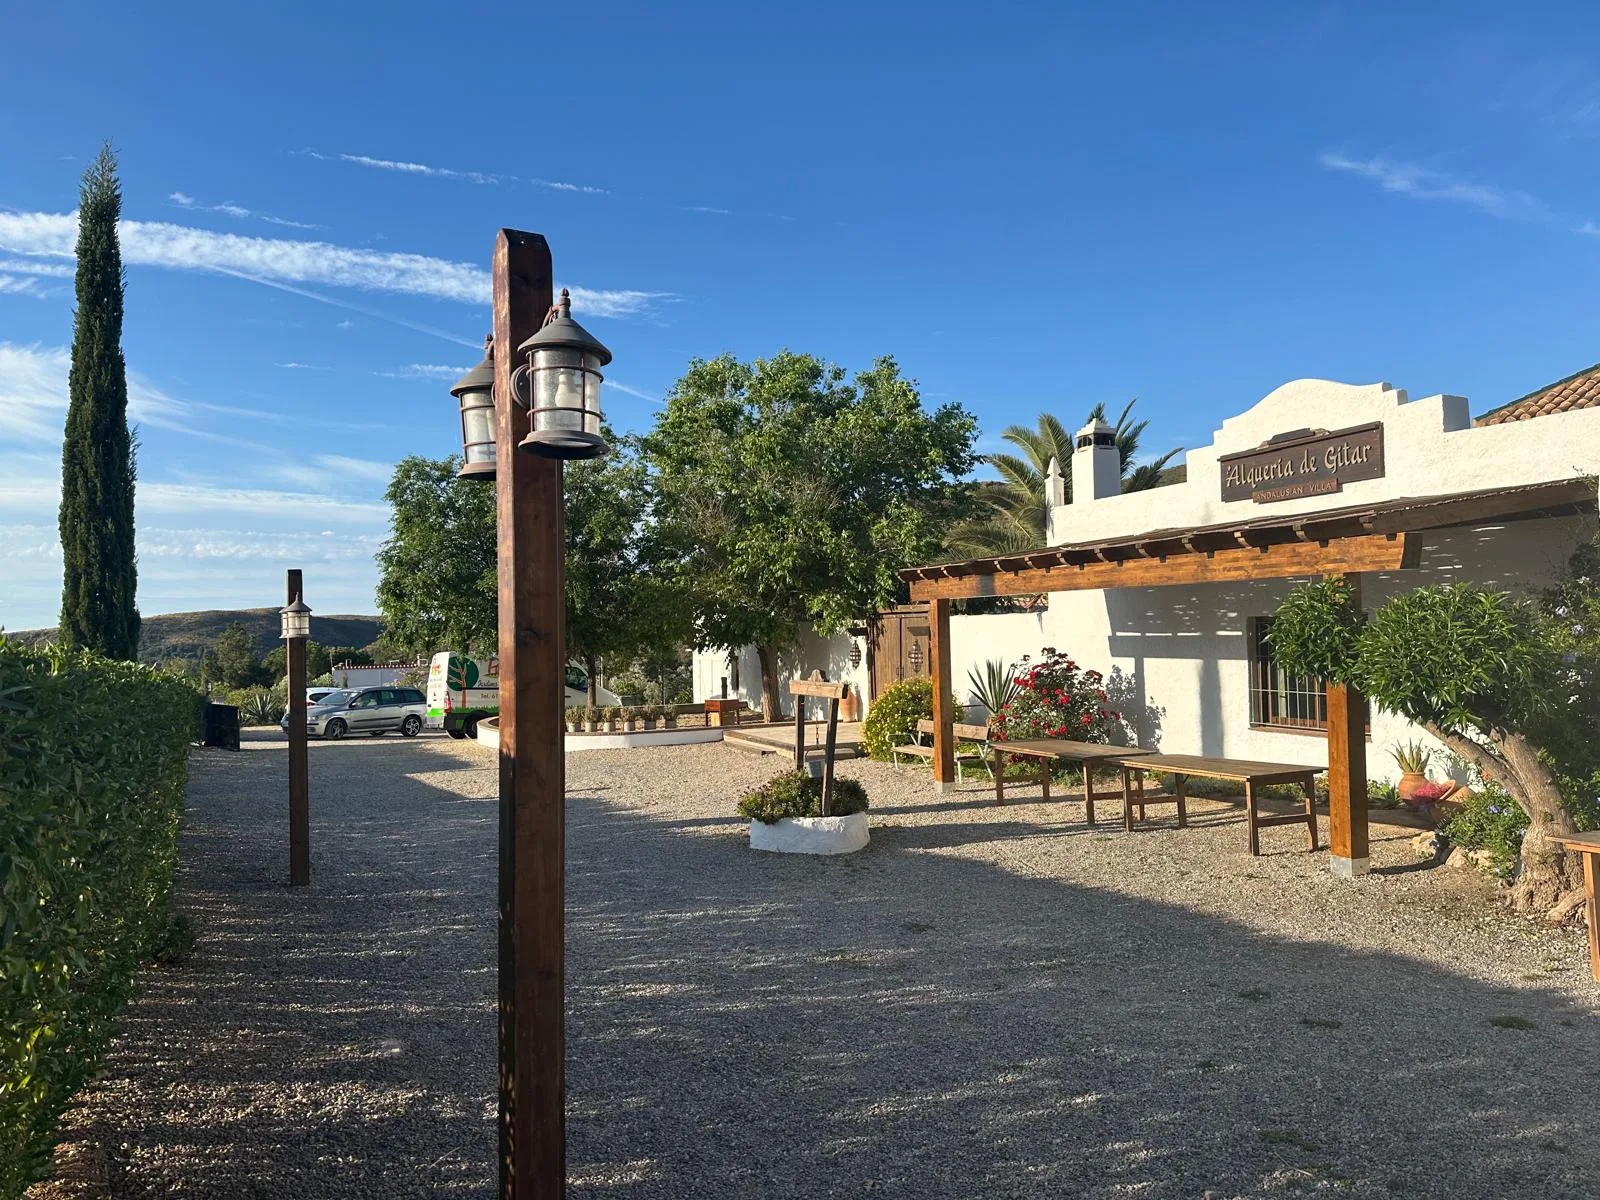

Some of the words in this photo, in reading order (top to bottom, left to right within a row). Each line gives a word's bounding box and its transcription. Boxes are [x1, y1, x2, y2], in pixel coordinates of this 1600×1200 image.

[1299, 448, 1318, 474] de
[1324, 442, 1371, 474] Gitar
[1256, 487, 1303, 500] ANDALUSIAN
[1309, 482, 1332, 492] VILLA
